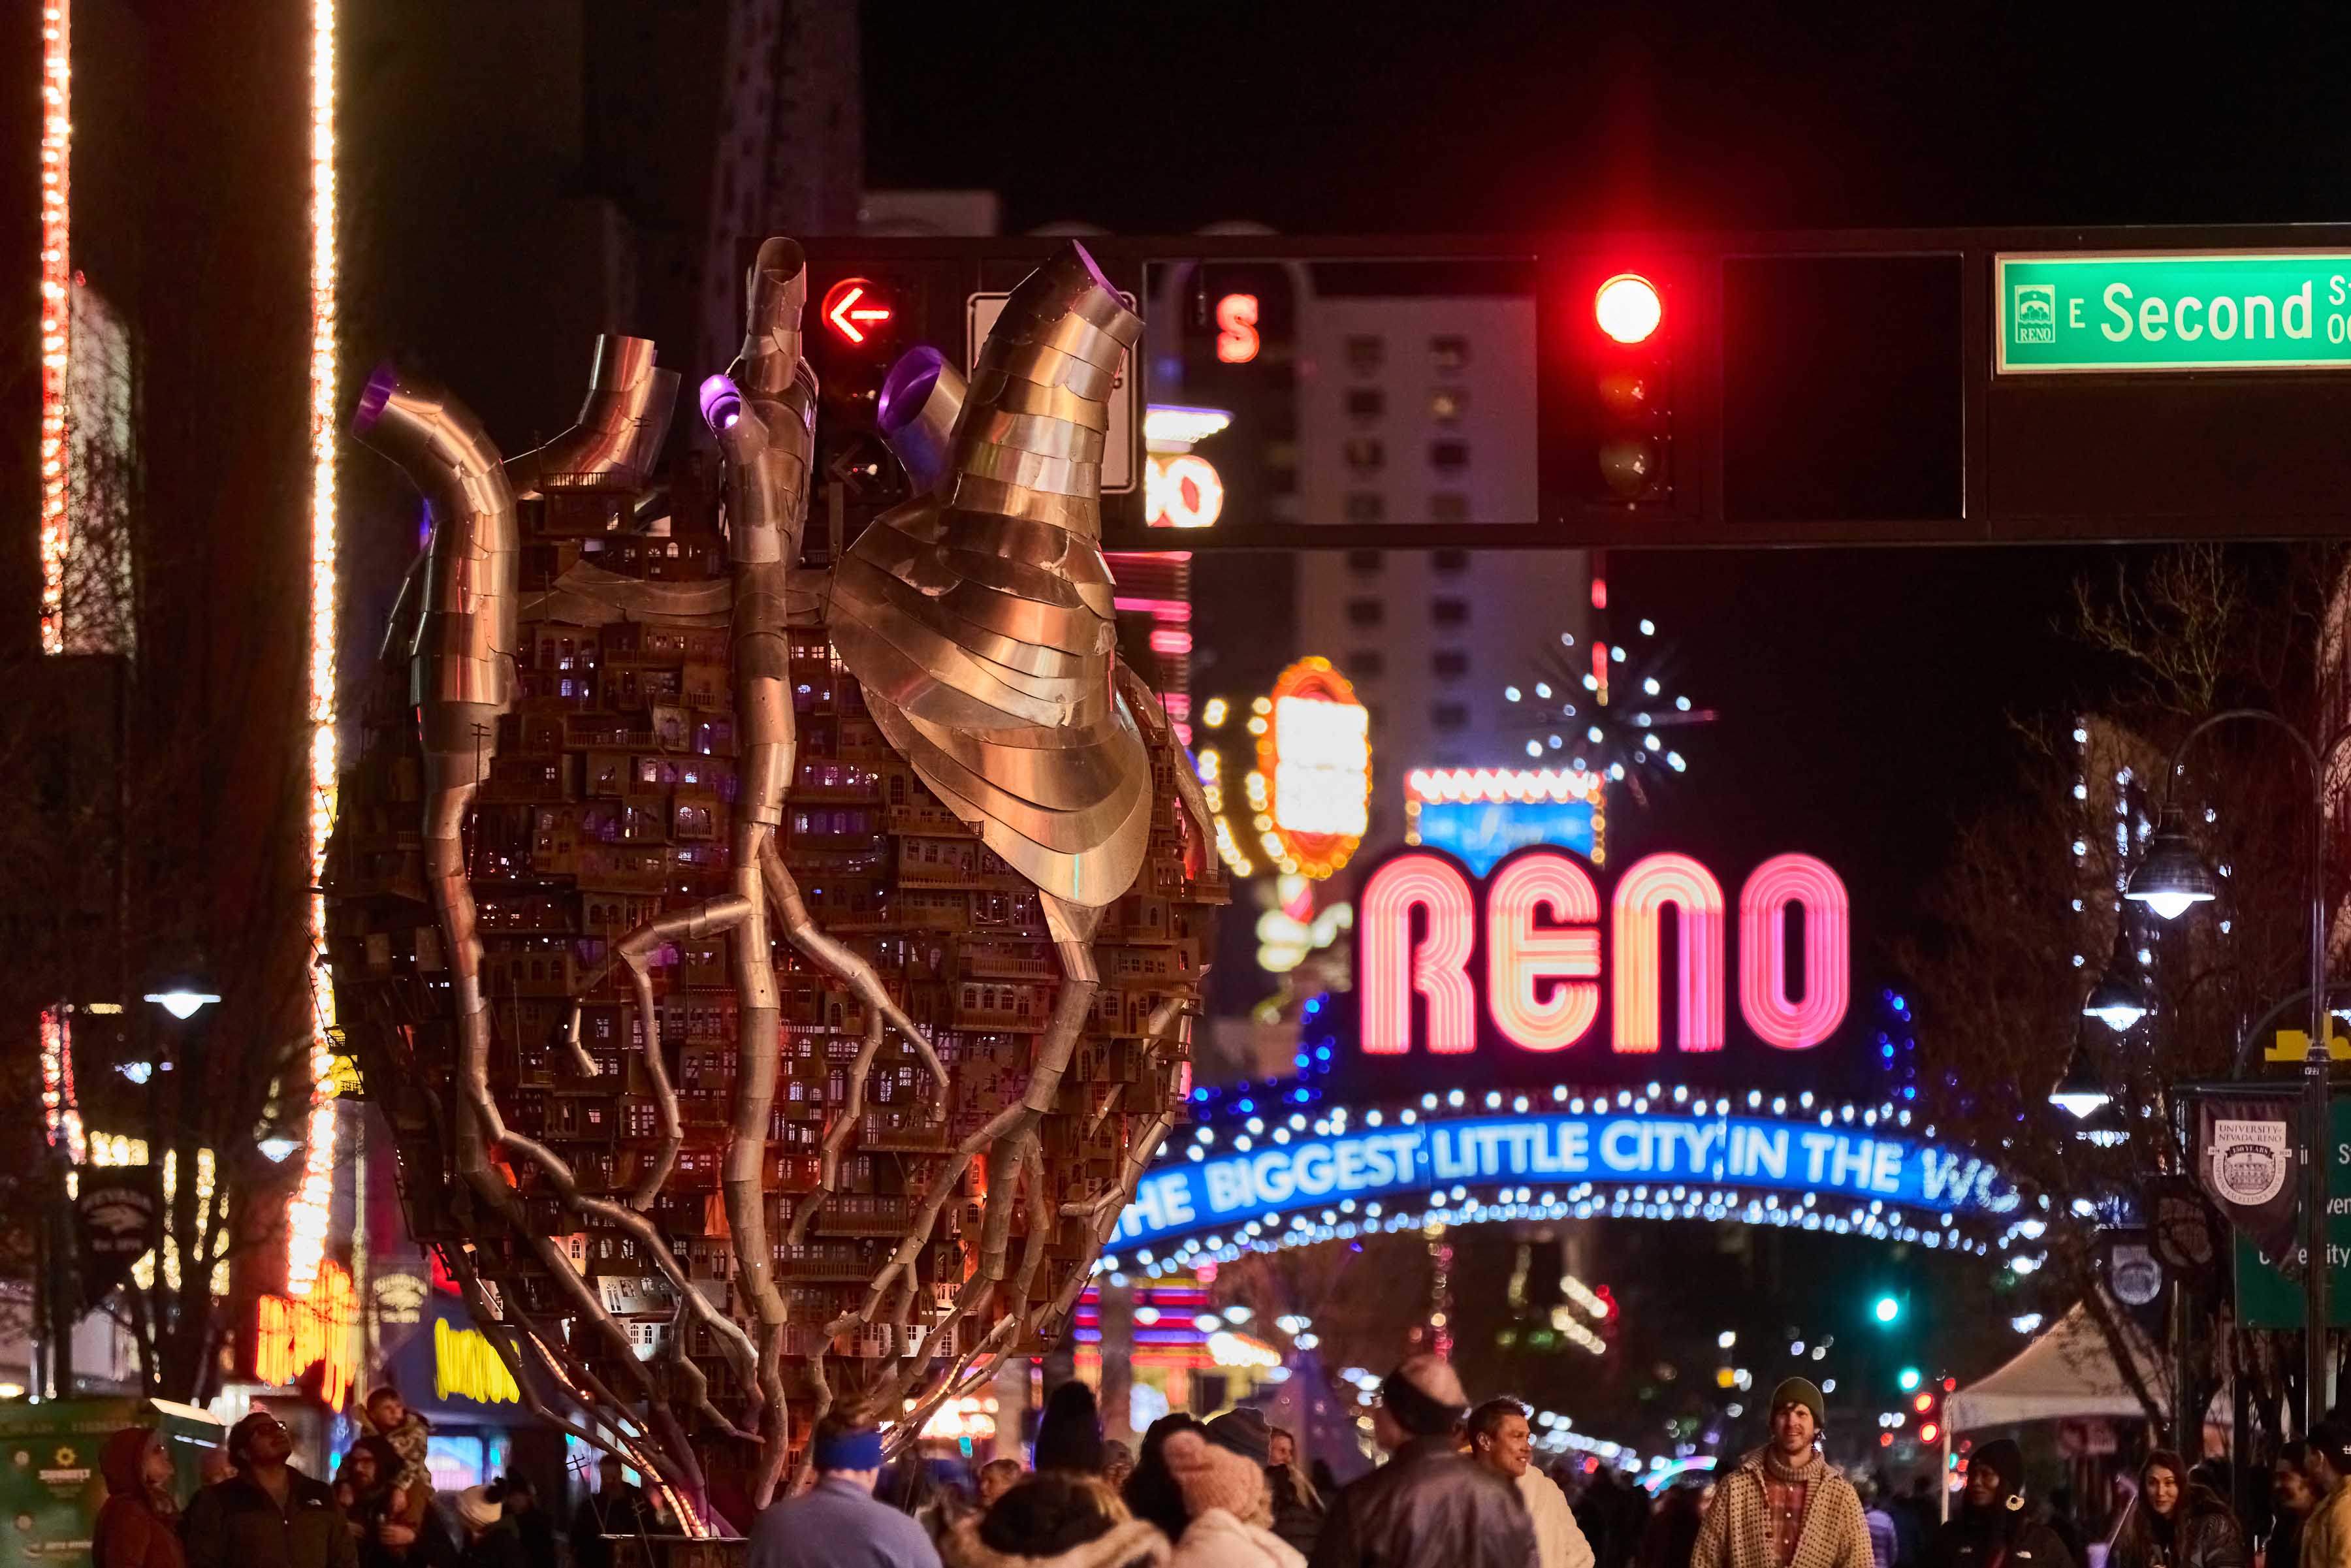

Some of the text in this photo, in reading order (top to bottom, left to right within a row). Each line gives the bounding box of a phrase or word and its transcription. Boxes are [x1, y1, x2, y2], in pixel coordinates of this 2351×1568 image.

[2328, 275, 2351, 306] S
[2070, 280, 2312, 342] E Second
[2021, 328, 2051, 341] RENO
[1361, 852, 1851, 1053] RENO
[2219, 1125, 2279, 1134] UNIVERSITY
[2246, 1145, 2269, 1154] YEARS
[1109, 1174, 1196, 1243] HE
[1203, 1132, 1422, 1213] BIGGEST
[1433, 1122, 1588, 1179] LITTLE
[1599, 1119, 1716, 1173] CITY
[1731, 1125, 1789, 1179] IN
[1800, 1130, 1904, 1193] THE
